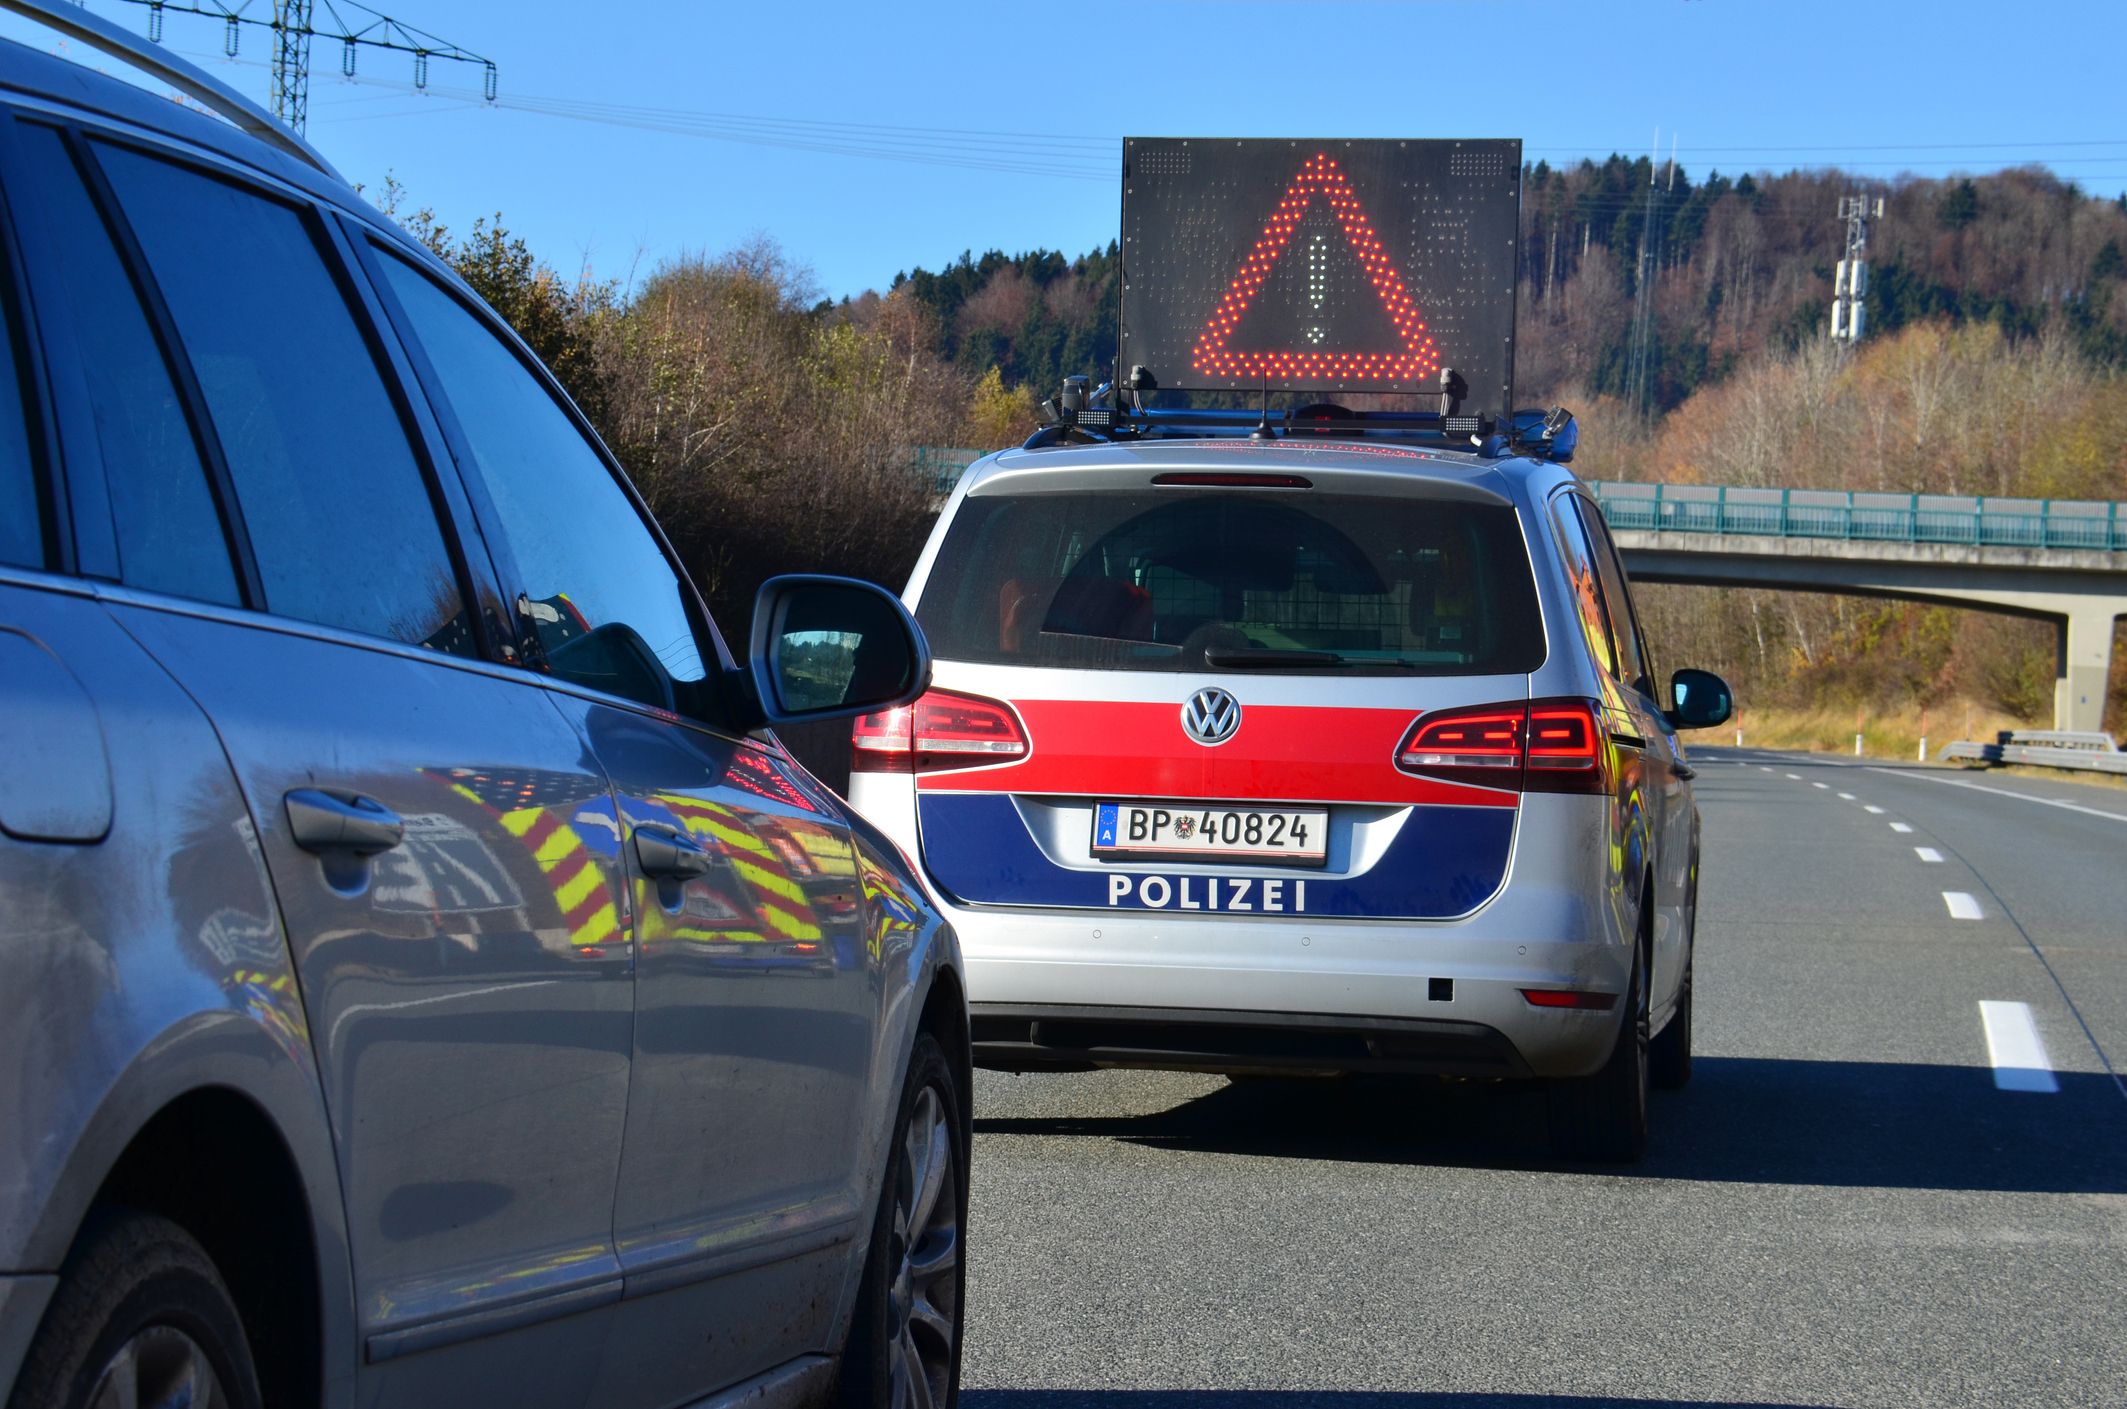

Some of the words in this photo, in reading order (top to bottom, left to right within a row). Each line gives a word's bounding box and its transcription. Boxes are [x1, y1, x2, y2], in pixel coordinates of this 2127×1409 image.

[1184, 689, 1239, 738] VW
[1102, 830, 1112, 840] A
[1128, 809, 1171, 842] BP
[1199, 811, 1308, 848] 40824
[1109, 874, 1305, 911] POLIZEI
